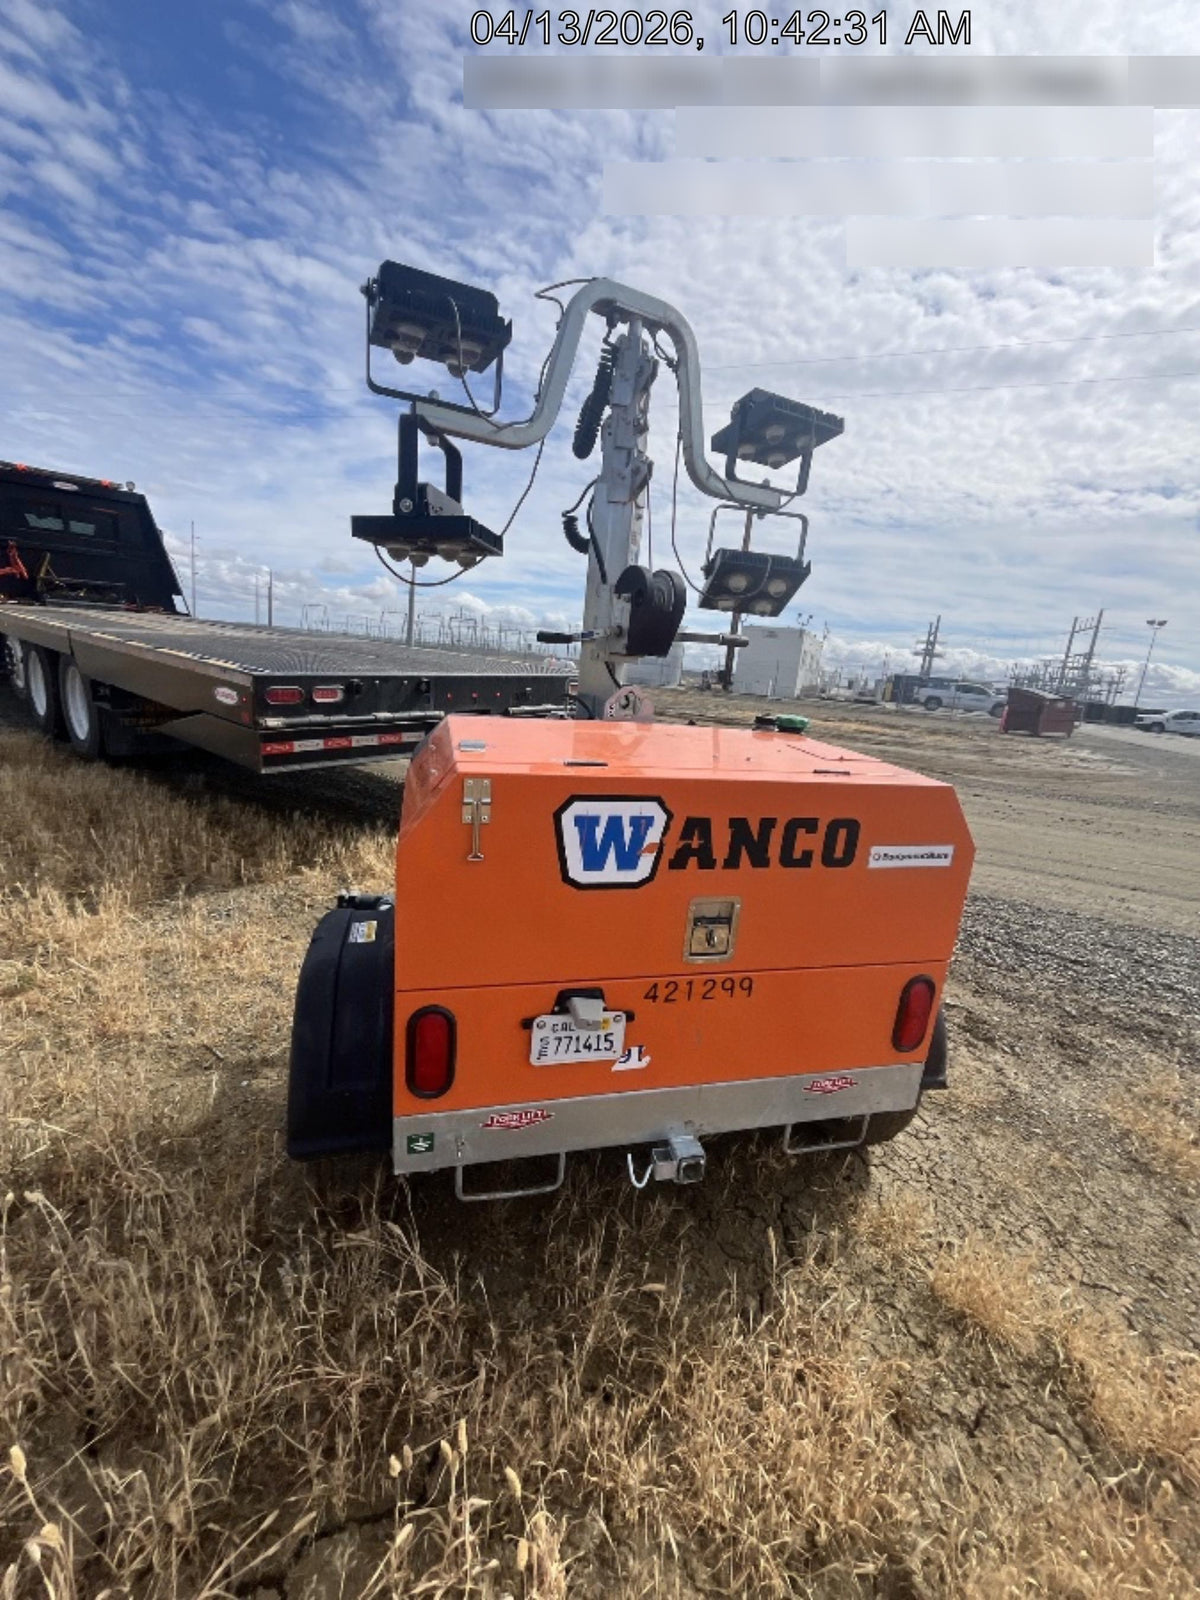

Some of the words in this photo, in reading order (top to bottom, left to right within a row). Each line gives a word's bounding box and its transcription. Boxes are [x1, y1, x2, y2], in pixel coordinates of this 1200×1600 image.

[573, 815, 861, 872] WANCO
[643, 976, 753, 1003] 421299
[553, 1032, 614, 1055] 771415
